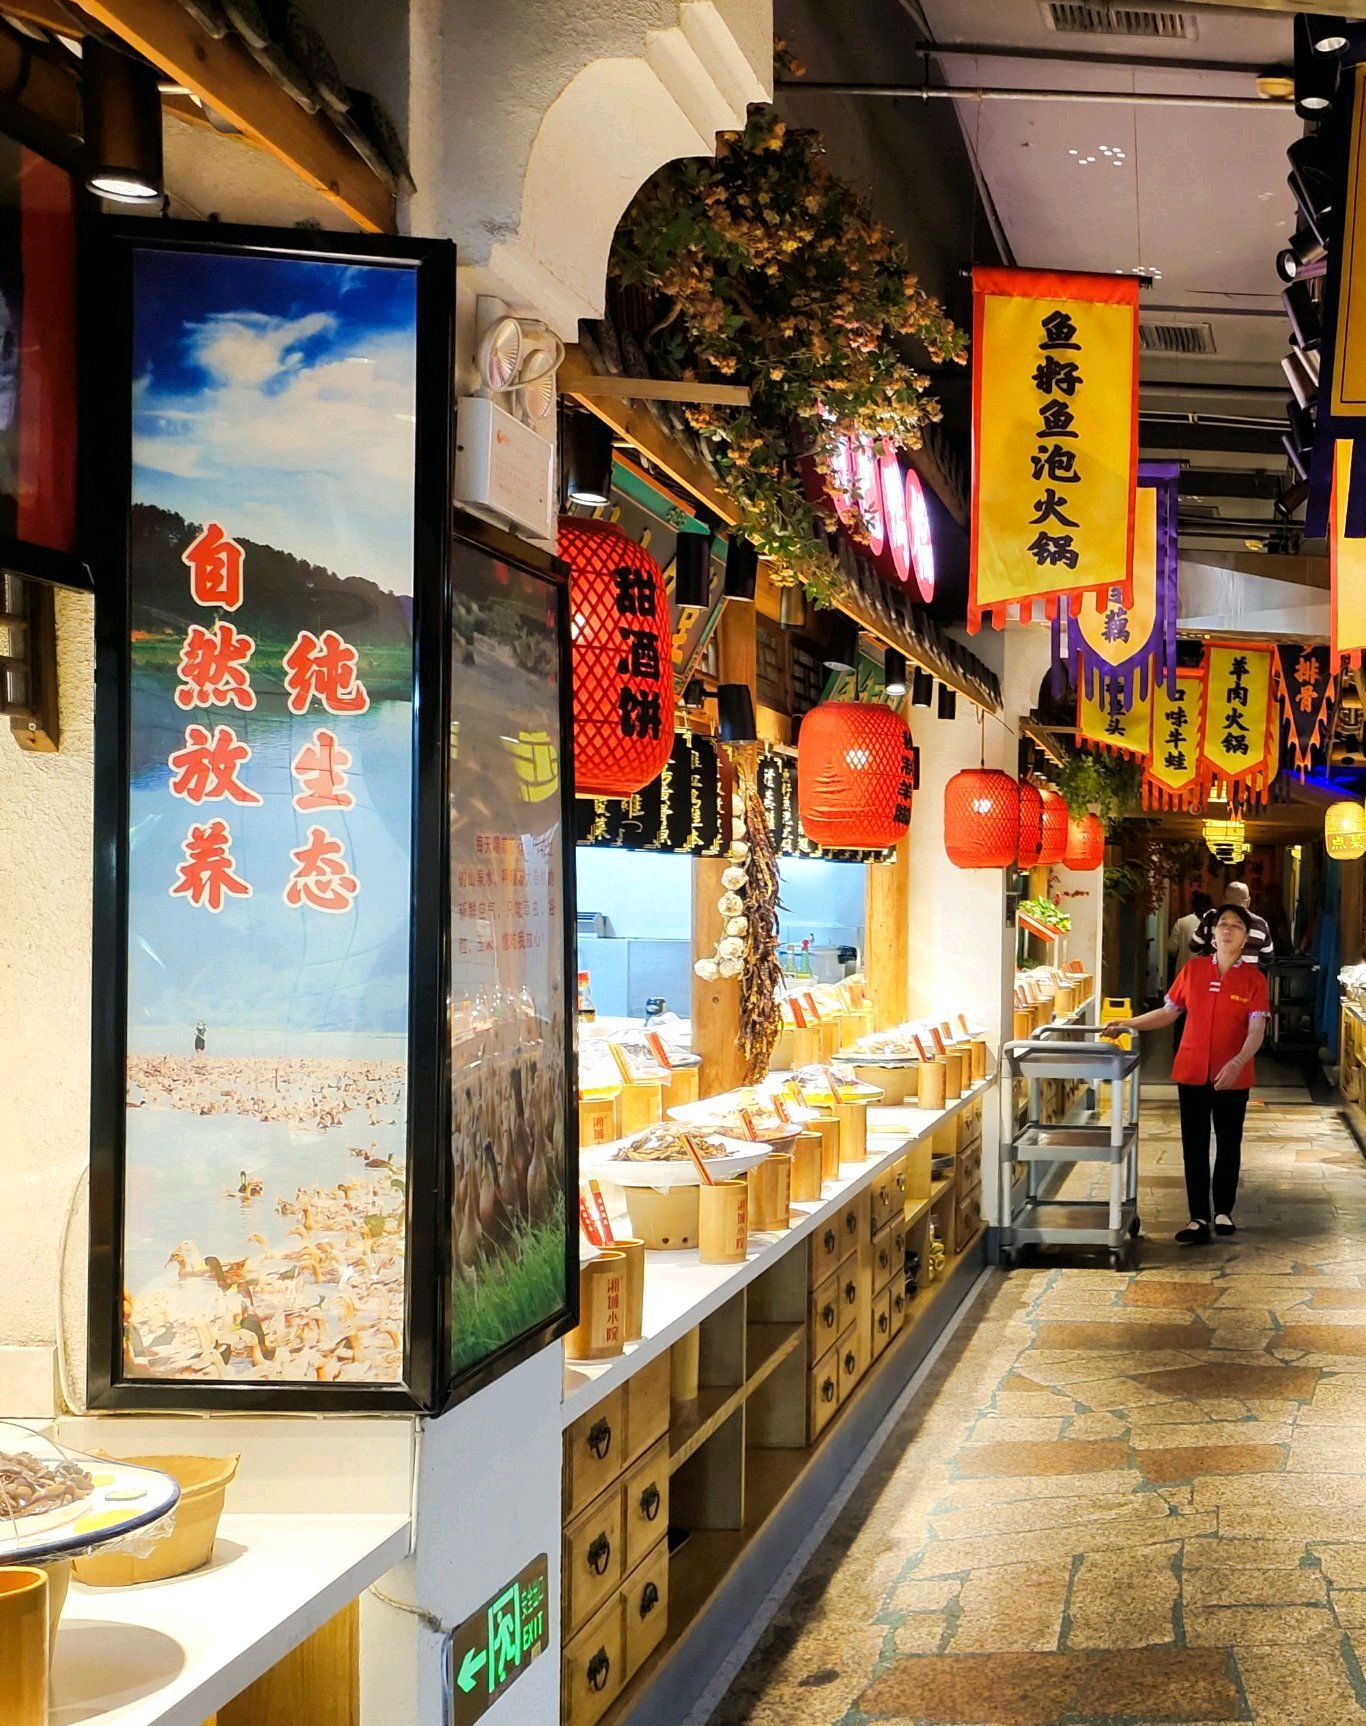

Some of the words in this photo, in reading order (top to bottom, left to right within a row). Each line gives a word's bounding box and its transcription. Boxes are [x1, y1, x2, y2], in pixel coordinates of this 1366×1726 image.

[1027, 310, 1083, 570] 鱼籽鱼泡火锅
[170, 523, 264, 912] 自然放养
[613, 566, 661, 739] 甜酒饼
[1221, 655, 1250, 755] 羊肉火锅
[1294, 657, 1320, 713] 排骨
[283, 631, 369, 913] 纯生态
[1164, 689, 1189, 770] 口味牛蛙
[523, 1611, 543, 1651] EXIT
